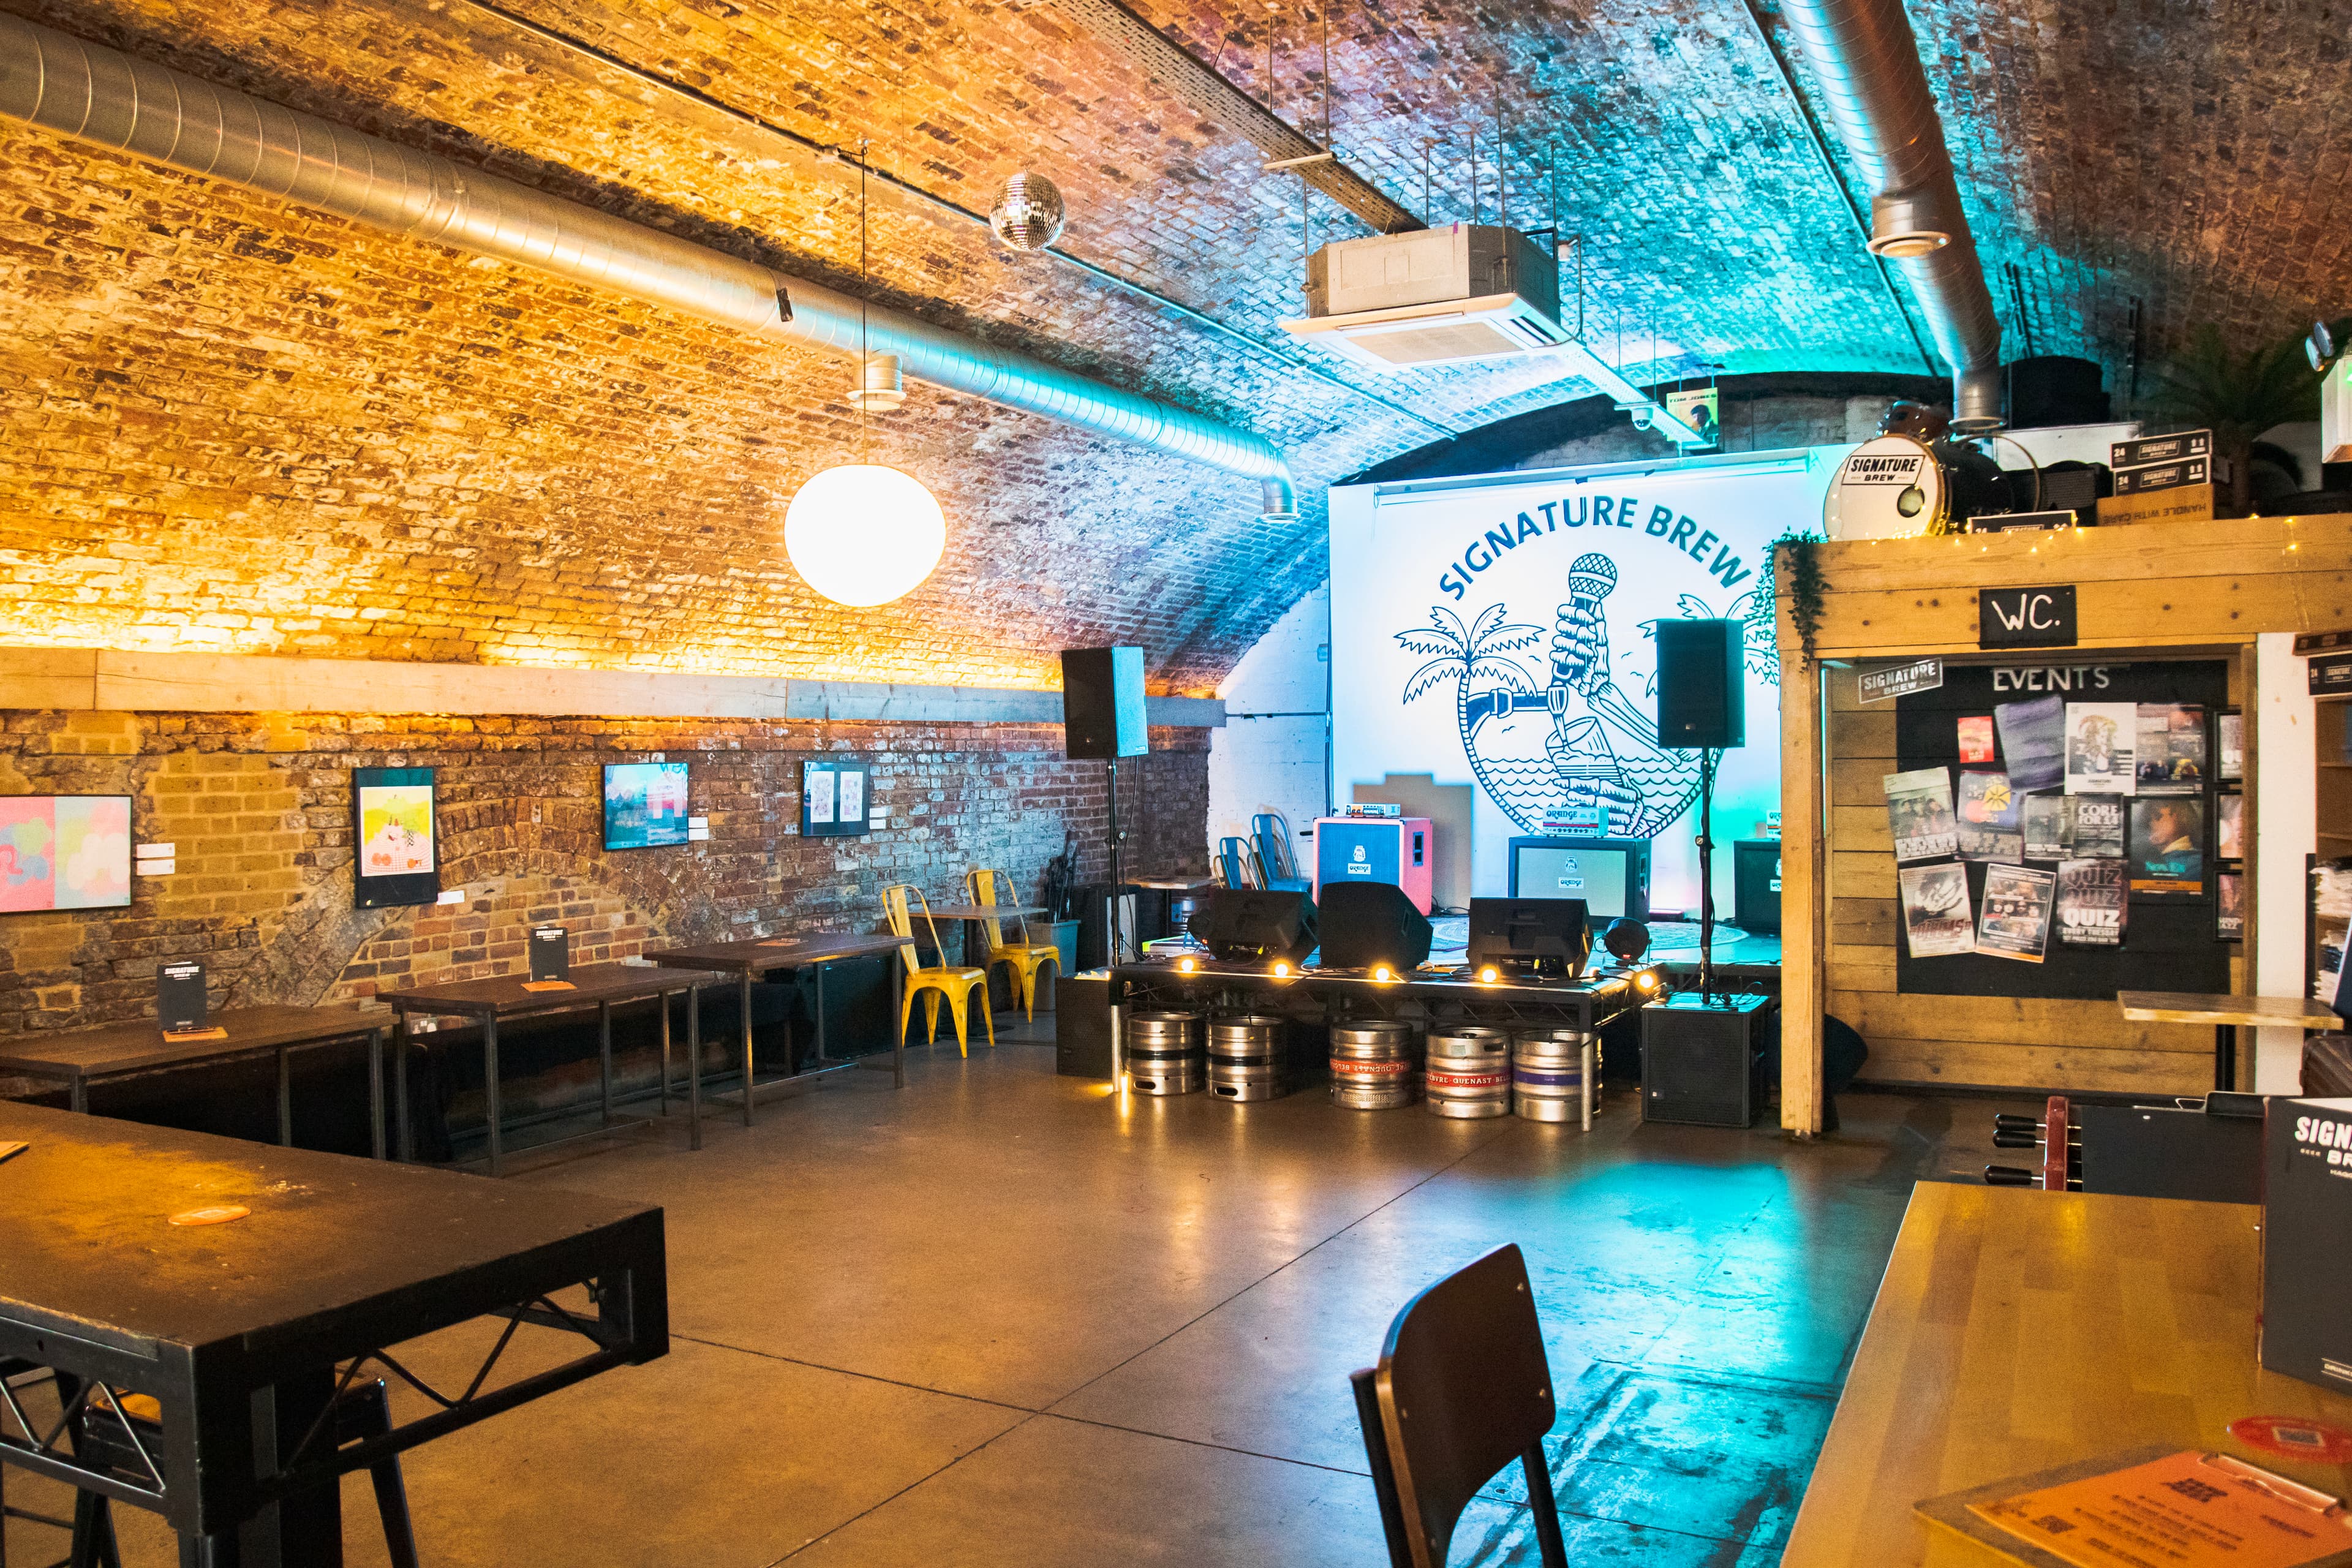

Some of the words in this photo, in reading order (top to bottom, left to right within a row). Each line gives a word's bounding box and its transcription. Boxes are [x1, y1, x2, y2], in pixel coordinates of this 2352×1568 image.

[2114, 447, 2126, 458] 24
[1850, 458, 1918, 472] SIGNATURE
[2117, 475, 2130, 486] 24
[2163, 503, 2206, 517] HANDLE
[1439, 495, 1638, 601] SIGNATURE
[1645, 504, 1751, 589] BREW
[1864, 662, 1936, 690] SIGNATURE
[1993, 666, 2110, 692] EVENTS
[1883, 681, 1918, 695] BREW
[1547, 810, 1578, 820] ORANGE
[2078, 804, 2118, 816] CORE
[2063, 908, 2120, 928] QUIZ
[2294, 1116, 2352, 1150] SIGN
